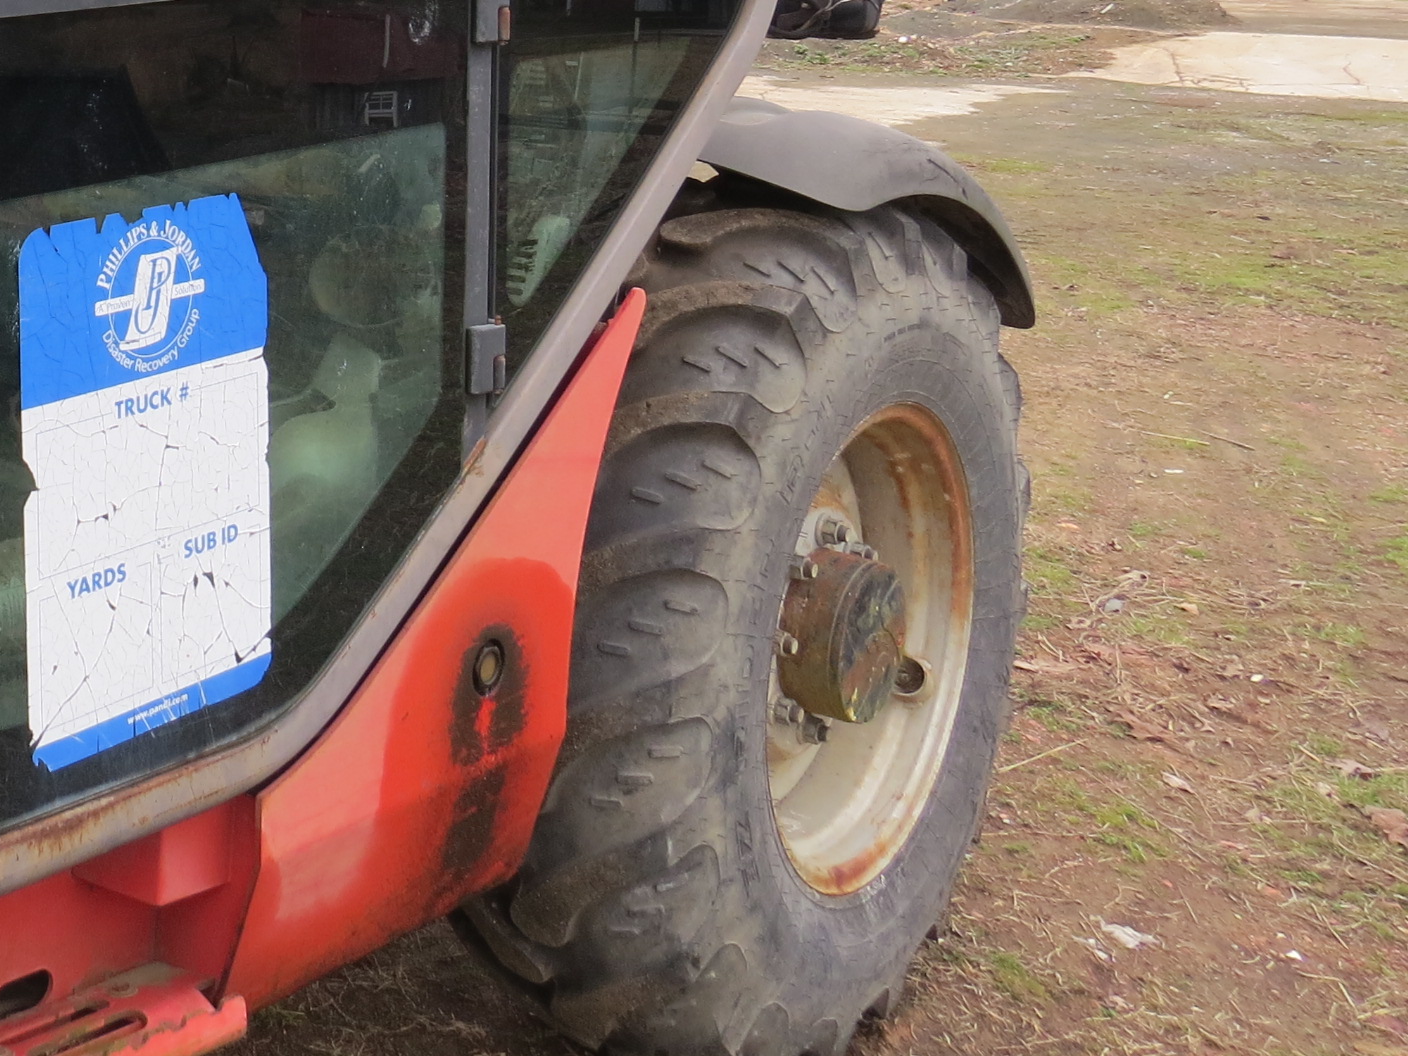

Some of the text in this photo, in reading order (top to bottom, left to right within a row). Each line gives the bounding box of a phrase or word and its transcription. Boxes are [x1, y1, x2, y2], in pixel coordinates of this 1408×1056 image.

[96, 219, 202, 290] PHILLIPS & JORDAN
[102, 308, 201, 373] Disaster Recovery Group
[114, 382, 190, 421] TRUCK #
[183, 523, 239, 559] SUB ID
[66, 562, 127, 600] YARDS
